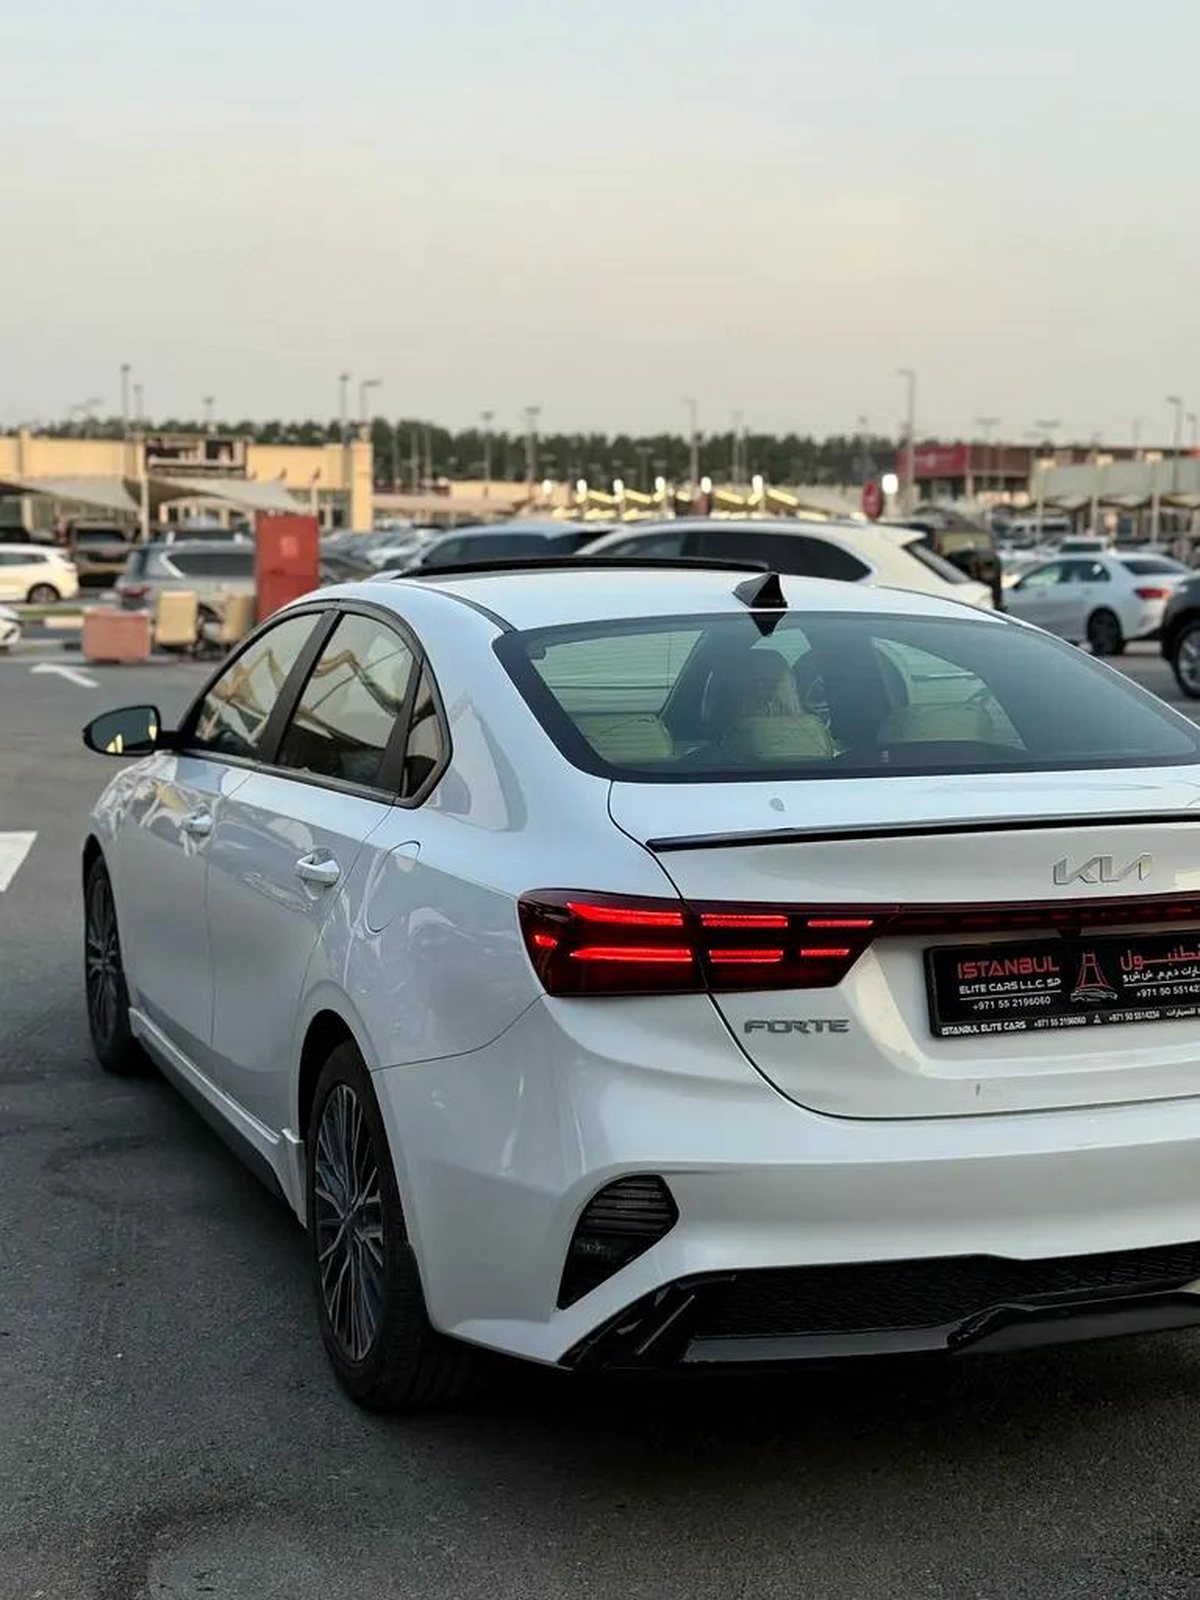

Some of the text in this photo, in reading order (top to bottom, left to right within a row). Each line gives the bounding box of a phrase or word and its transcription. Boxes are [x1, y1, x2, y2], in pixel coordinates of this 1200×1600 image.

[1053, 852, 1151, 885] KIA
[1120, 944, 1200, 971] طنبول
[957, 956, 1060, 979] ISTANBUL
[959, 984, 987, 995] ELITE
[989, 981, 1018, 992] CARS
[1137, 984, 1200, 998] +971 50 55142
[972, 1001, 995, 1010] +971
[998, 1000, 1010, 1009] 55
[744, 1019, 850, 1034] FORTE
[941, 1020, 1027, 1036] ISTANBUL ELITE CARS
